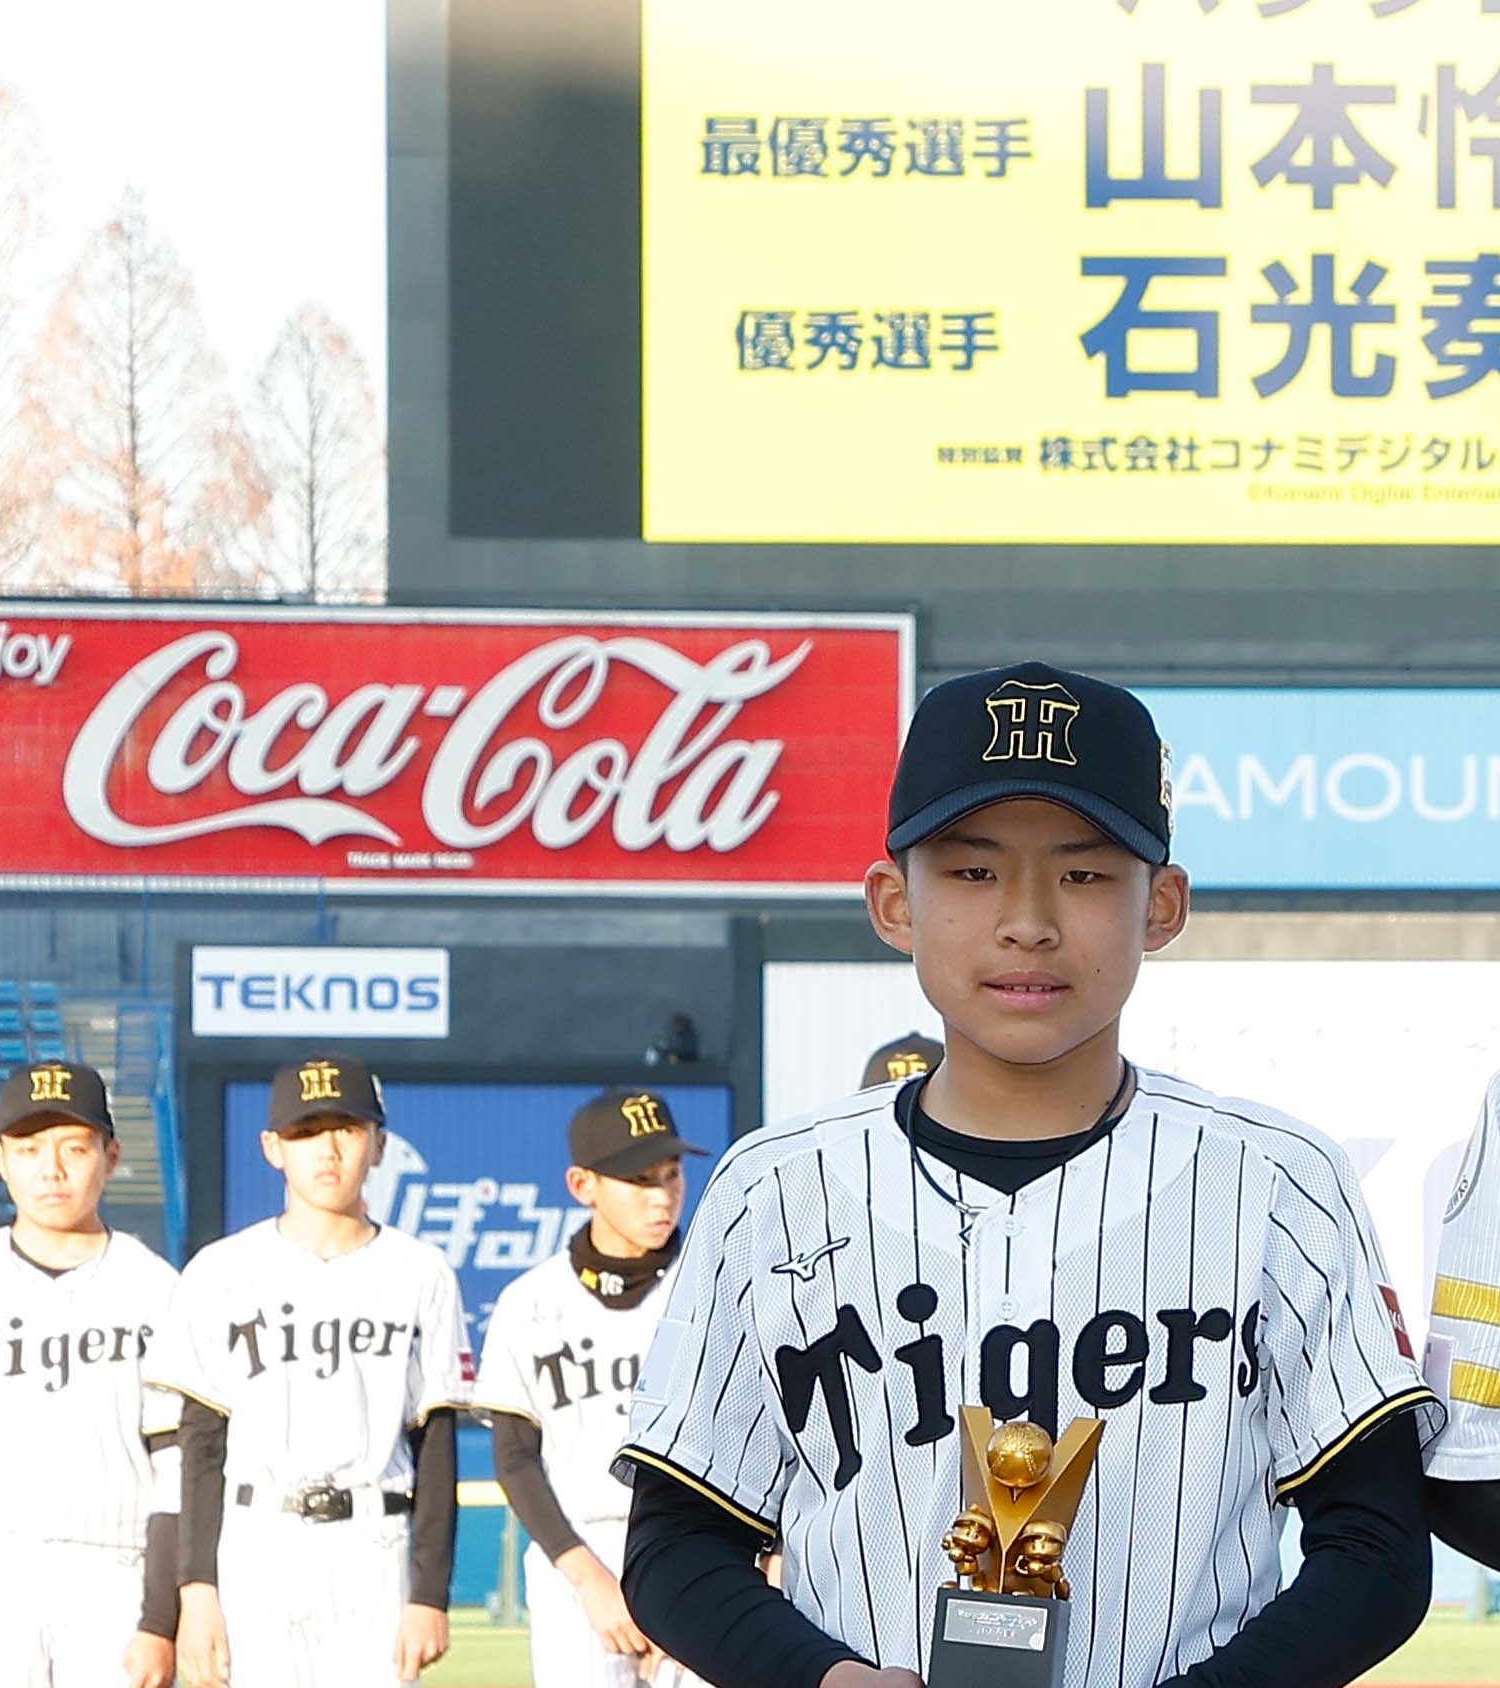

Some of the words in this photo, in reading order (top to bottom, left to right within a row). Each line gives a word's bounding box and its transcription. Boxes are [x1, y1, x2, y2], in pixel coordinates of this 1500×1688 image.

[700, 116, 1032, 178] 最優秀選手
[734, 310, 999, 371] 優秀選手
[63, 630, 814, 854] Coca-Cola
[198, 974, 440, 1014] TEKNOS
[228, 1303, 420, 1382] Tiger
